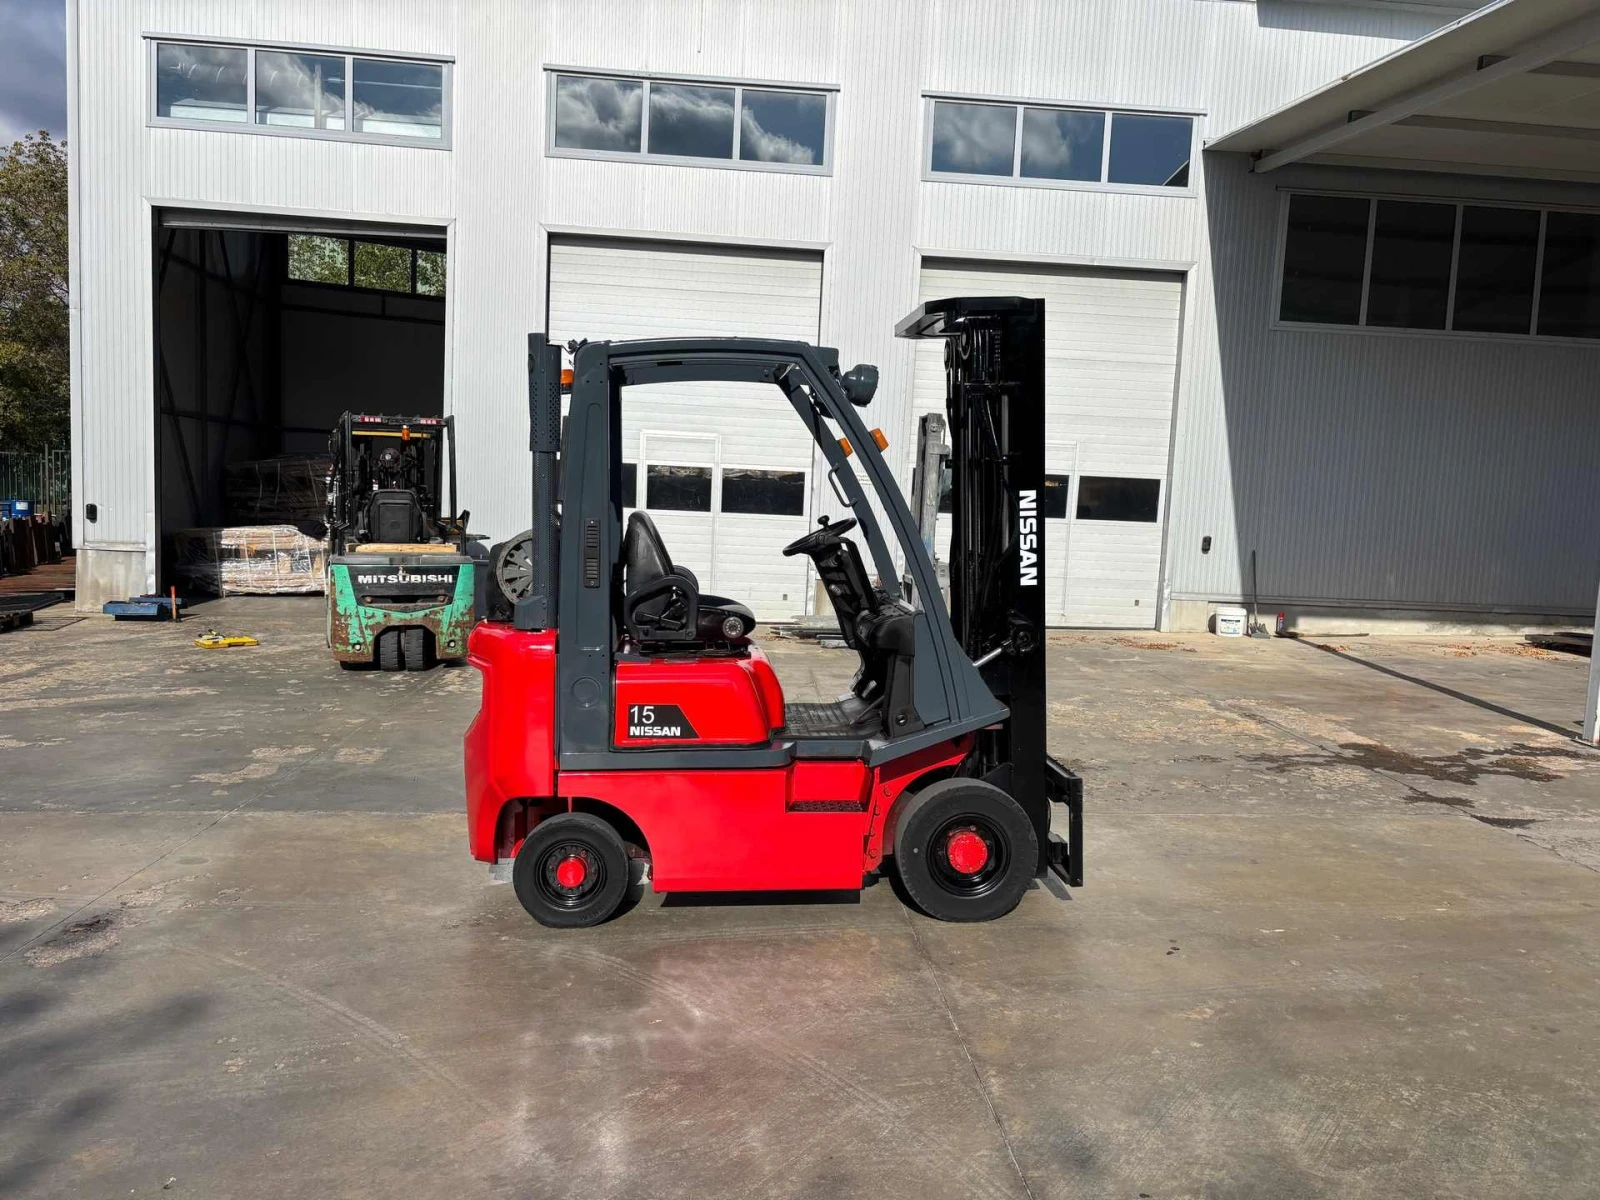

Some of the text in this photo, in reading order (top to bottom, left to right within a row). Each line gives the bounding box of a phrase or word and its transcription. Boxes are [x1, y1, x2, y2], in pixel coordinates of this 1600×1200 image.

[1019, 490, 1037, 586] NISSAN
[358, 575, 453, 584] MITSUBISHI
[630, 705, 655, 724] 15
[630, 726, 681, 736] NISSAN
